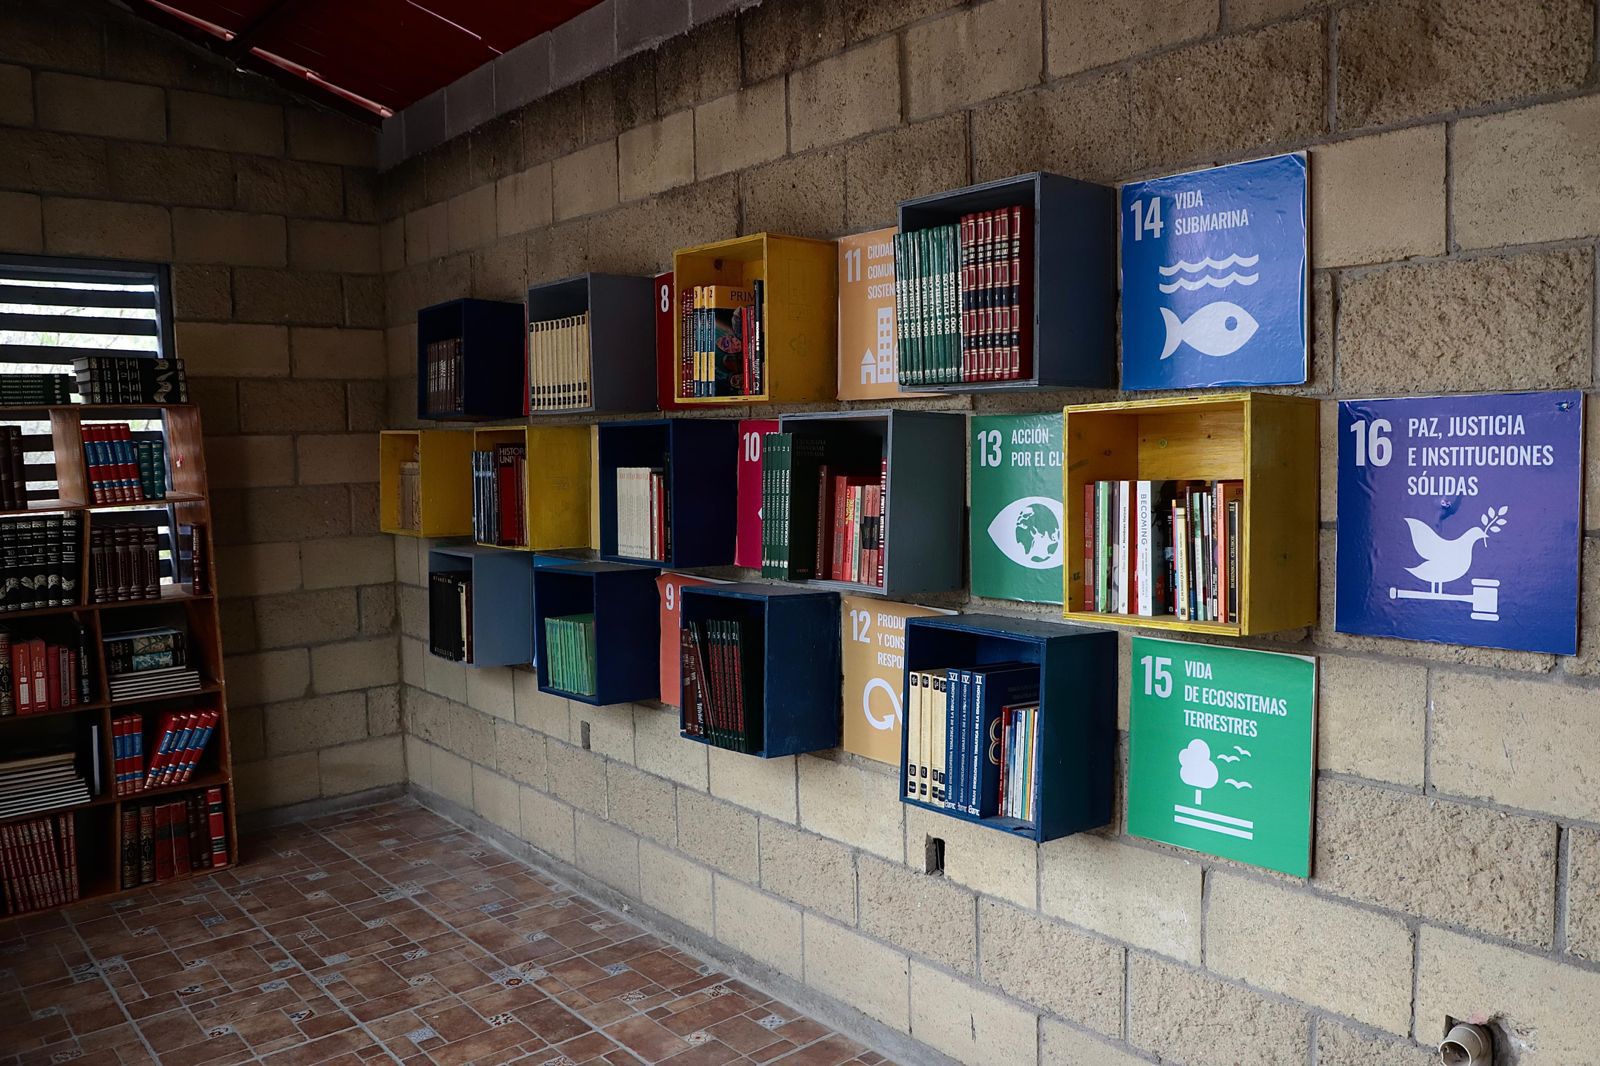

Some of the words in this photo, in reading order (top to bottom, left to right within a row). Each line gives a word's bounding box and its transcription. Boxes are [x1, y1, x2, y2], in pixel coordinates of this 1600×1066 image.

[1175, 190, 1204, 210] VIDA
[1130, 196, 1164, 241] 14
[1175, 209, 1249, 236] SUBMARINA
[845, 248, 860, 282] 11
[661, 284, 669, 312] 8
[1012, 424, 1048, 444] ACCIÓN
[1408, 418, 1442, 440] PAZ,
[1448, 414, 1526, 437] JUSTICIA
[743, 432, 760, 462] 10
[978, 430, 1002, 467] 13
[1350, 418, 1392, 466] 16
[1408, 448, 1416, 466] E
[1422, 445, 1554, 466] INSTITUCIONES
[1012, 452, 1031, 467] POR
[1035, 452, 1045, 466] EL
[1408, 470, 1478, 496] SÓLIDAS
[666, 583, 674, 610] 9
[850, 610, 870, 643] 12
[877, 633, 882, 645] Y
[949, 672, 958, 682] VI
[961, 674, 970, 684] IV
[975, 674, 982, 684] II
[1140, 655, 1172, 698] 15
[1184, 660, 1212, 680] VIDA
[1184, 685, 1199, 703] DE
[1202, 687, 1288, 716] ECOSISTEMAS
[1184, 710, 1258, 738] TERRESTRES
